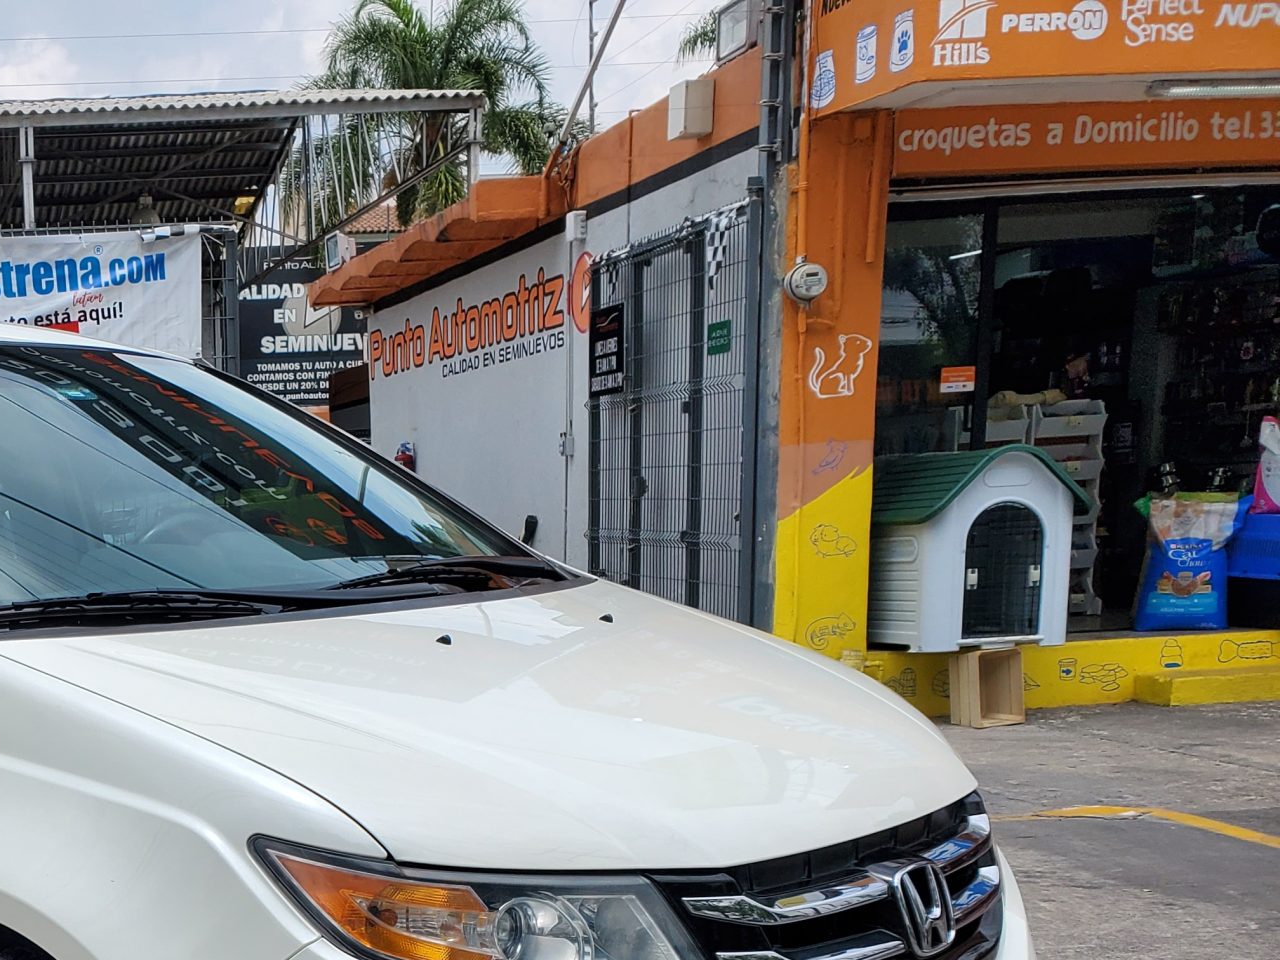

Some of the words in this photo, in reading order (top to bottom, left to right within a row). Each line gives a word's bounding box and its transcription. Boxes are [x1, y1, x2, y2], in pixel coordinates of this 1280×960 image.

[1001, 10, 1103, 33] PERRON
[1214, 3, 1280, 27] NUP
[1125, 14, 1194, 47] Sense
[933, 42, 990, 66] Hill's
[898, 117, 1031, 156] croquetas
[1046, 122, 1064, 145] a
[1073, 113, 1199, 145] Domicilio
[239, 283, 305, 300] ALIDAD
[34, 307, 71, 327] está
[78, 301, 124, 326] aquí!
[274, 309, 296, 323] EN
[369, 318, 425, 380] Punto
[428, 267, 564, 364] Automotriz
[260, 333, 363, 354] SEMINUEV
[442, 355, 480, 378] CALIDAD
[483, 352, 496, 367] EN
[498, 331, 564, 362] SEMINUEVOS
[247, 372, 294, 382] CONTAMOS
[296, 372, 315, 380] CON
[317, 371, 331, 380] FIN
[257, 362, 300, 371] TOMAMOS
[302, 362, 313, 370] TU
[338, 361, 345, 369] A
[287, 382, 298, 390] UN
[300, 381, 318, 389] 20%
